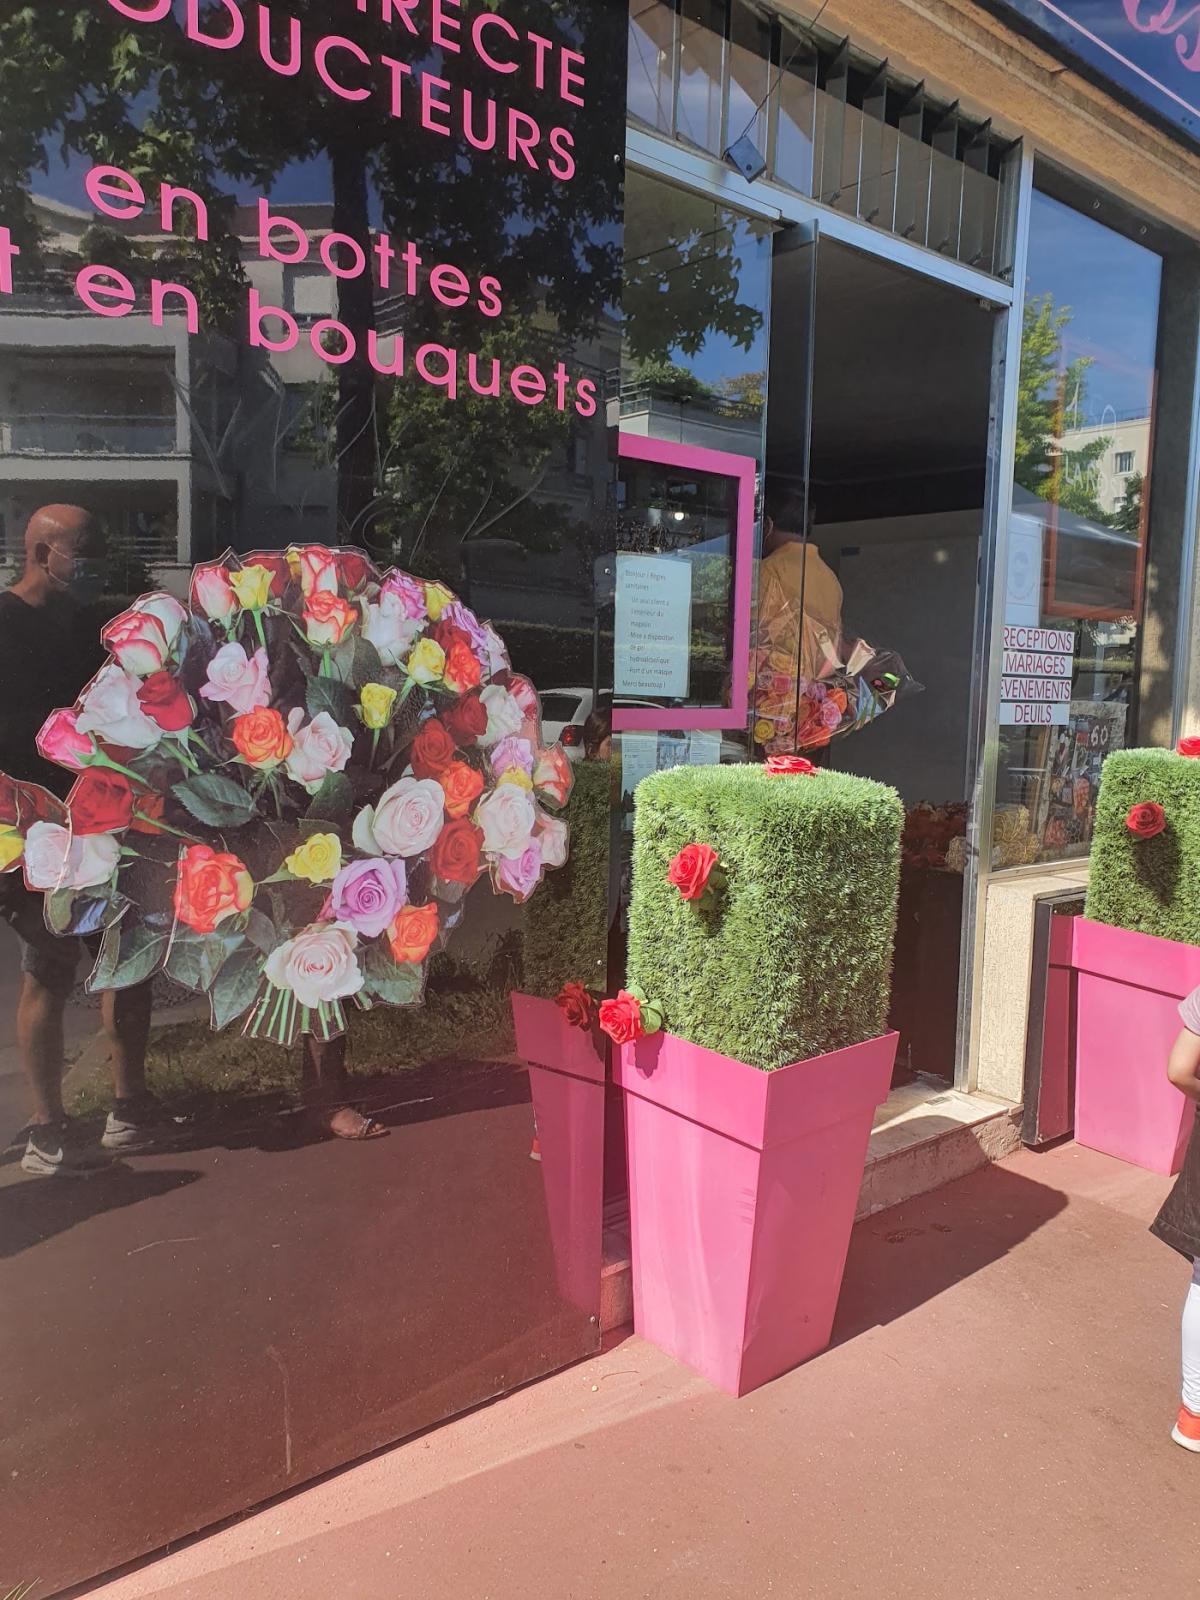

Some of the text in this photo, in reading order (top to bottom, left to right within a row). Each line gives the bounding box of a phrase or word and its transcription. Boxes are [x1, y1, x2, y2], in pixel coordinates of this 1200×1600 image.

[357, 0, 585, 107] RECTE
[85, 164, 502, 318] en bottes
[75, 263, 199, 334] en
[248, 288, 597, 417] bouquets
[1005, 653, 1066, 675] MARIAGES
[1014, 704, 1052, 724] DEUILS
